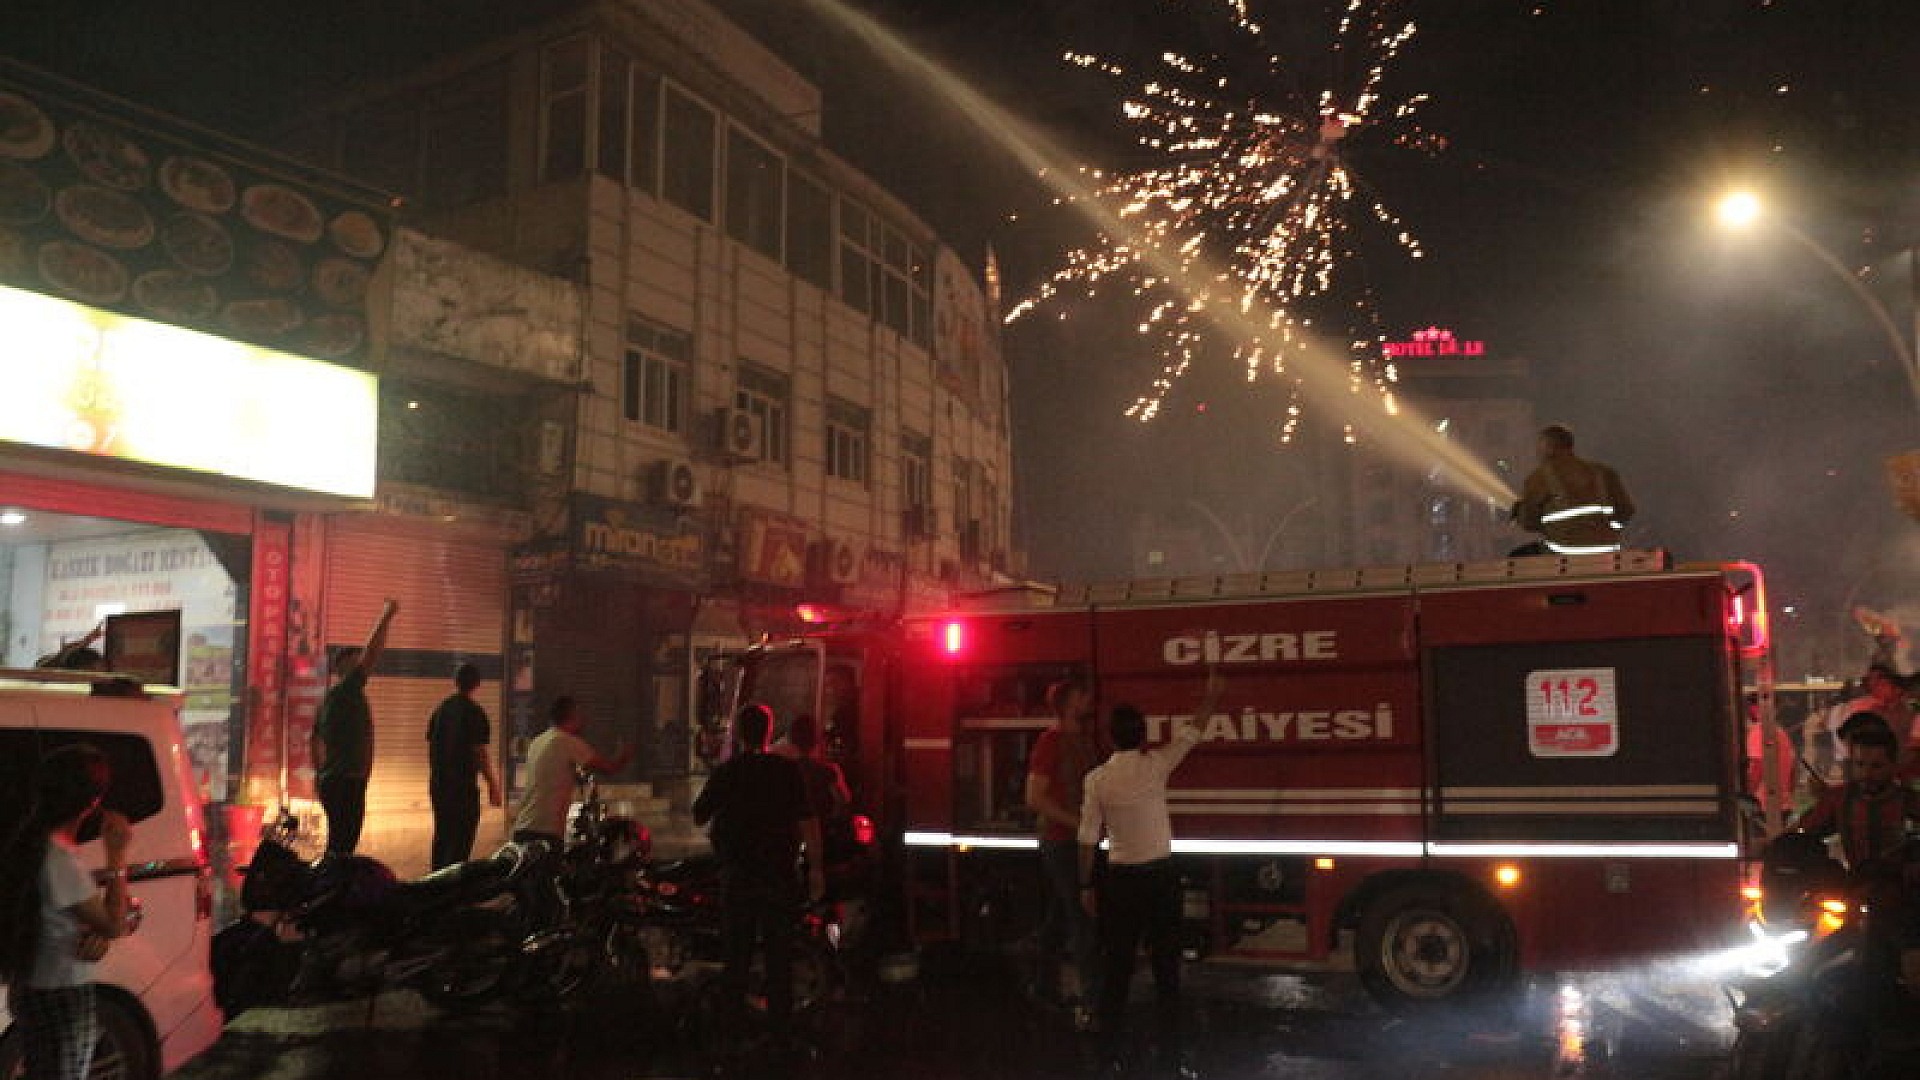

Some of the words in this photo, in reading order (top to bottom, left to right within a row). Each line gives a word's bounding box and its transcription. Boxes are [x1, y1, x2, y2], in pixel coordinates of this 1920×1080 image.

[1163, 630, 1338, 666] CİZRE
[1540, 678, 1598, 716] 112
[1144, 702, 1394, 743] TFAİYESİ
